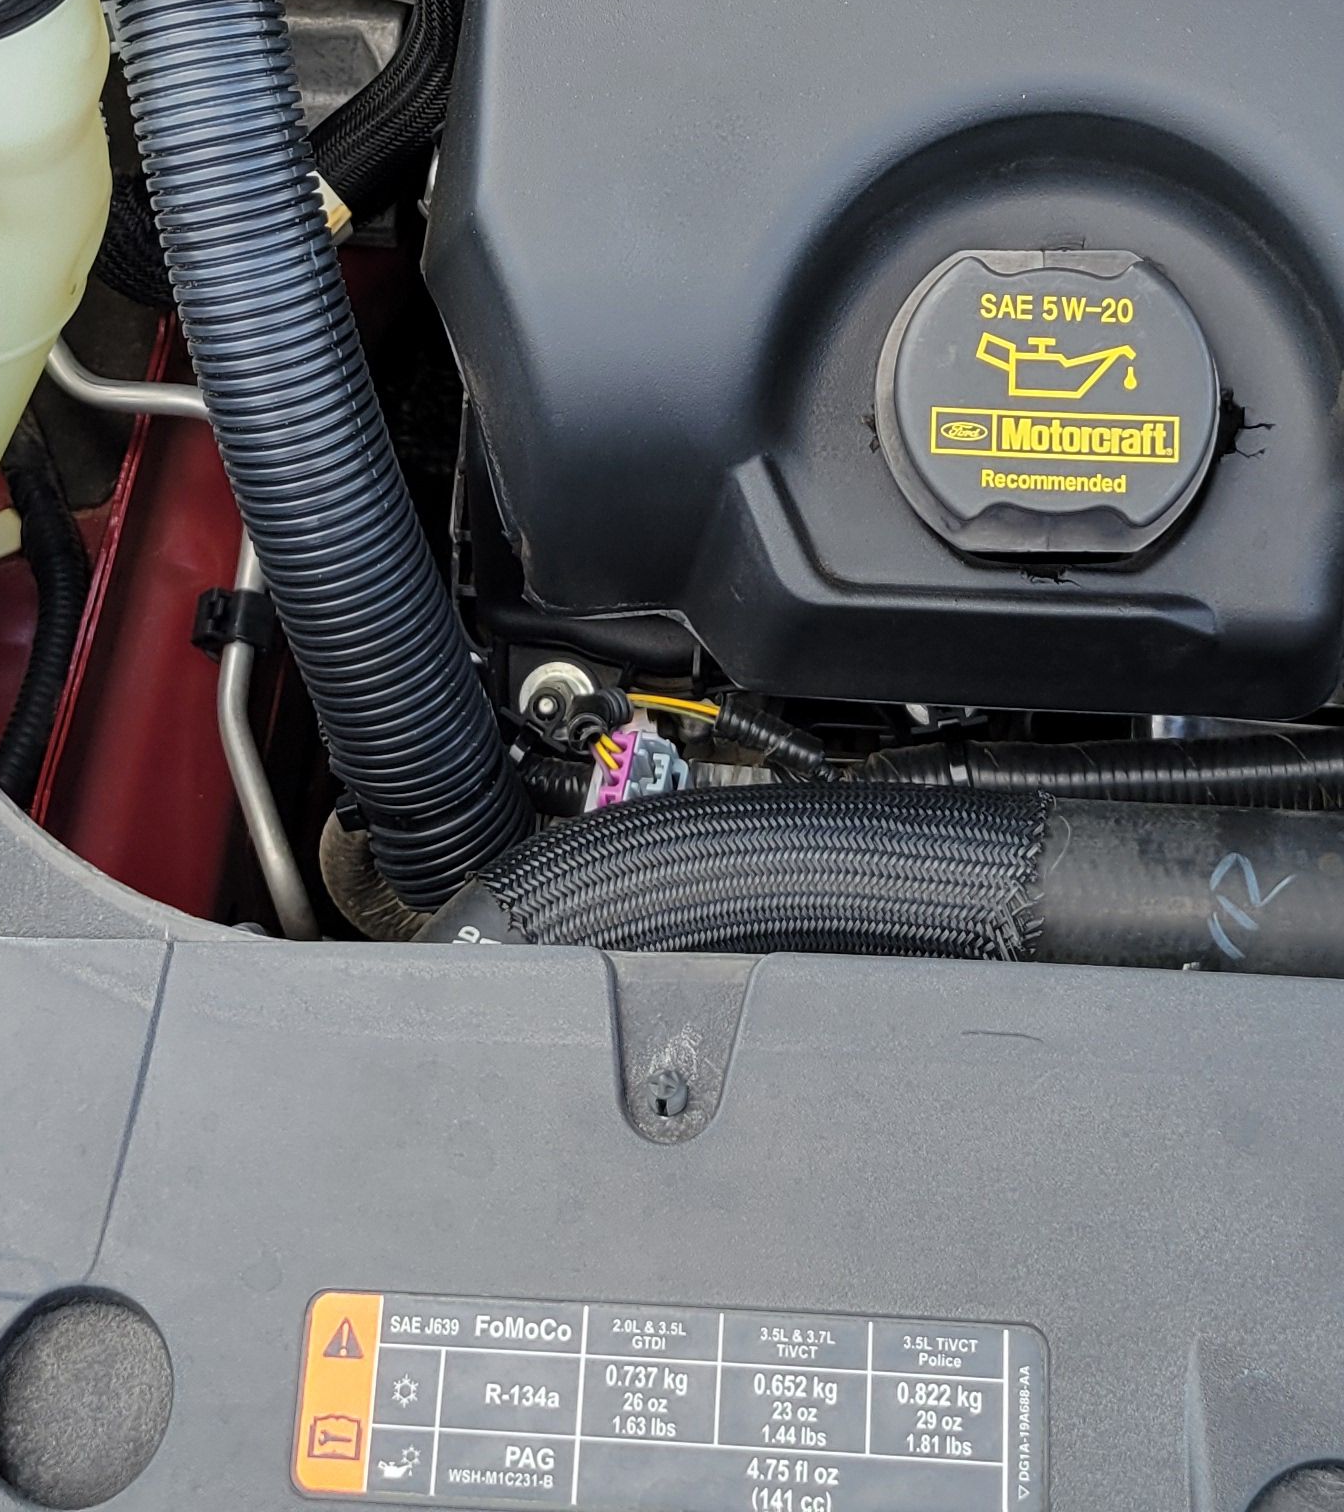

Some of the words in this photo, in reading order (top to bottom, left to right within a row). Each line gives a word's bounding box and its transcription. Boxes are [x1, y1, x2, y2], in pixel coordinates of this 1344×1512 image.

[980, 293, 1033, 320] SAE
[943, 422, 986, 439] Ford
[1001, 417, 1168, 456] Motorcraft
[981, 469, 1127, 493] Recommended
[390, 1315, 422, 1333] SAE
[424, 1317, 460, 1335] J639
[475, 1315, 572, 1341] FoMoCo
[612, 1319, 641, 1333] 2.0L
[644, 1320, 655, 1334] &
[658, 1321, 687, 1336] 3.5L
[760, 1327, 788, 1342] 3.5L
[792, 1329, 803, 1343] &
[806, 1330, 836, 1344] 3.7L
[631, 1335, 666, 1350] GTDI
[776, 1344, 818, 1359] TiVCT
[903, 1335, 933, 1350] 3.5L
[936, 1337, 978, 1353] TiVCT
[918, 1352, 962, 1368] Police
[605, 1364, 658, 1388] 0.737
[663, 1367, 688, 1396] kg
[754, 1373, 807, 1398] 0.652
[812, 1376, 838, 1405] kg
[485, 1383, 561, 1408] R-134a
[622, 1392, 644, 1411] 26
[647, 1397, 668, 1413] oz
[896, 1381, 951, 1406] 0.822
[957, 1385, 982, 1414] kg
[772, 1401, 792, 1420] 23
[797, 1406, 818, 1422] oz
[916, 1410, 937, 1429] 29
[941, 1415, 963, 1431] oz
[612, 1415, 646, 1435] 1.63
[650, 1417, 677, 1437] lbs
[761, 1424, 796, 1445] 1.44
[801, 1426, 827, 1446] lbs
[906, 1433, 940, 1454] 1.81
[946, 1435, 973, 1456] lbs
[504, 1445, 555, 1471] PAG
[448, 1468, 554, 1489] WSH-M1C231-B
[746, 1457, 790, 1482] 4.75
[795, 1460, 808, 1483] fl
[813, 1466, 839, 1485] oz
[752, 1486, 793, 1512] (141
